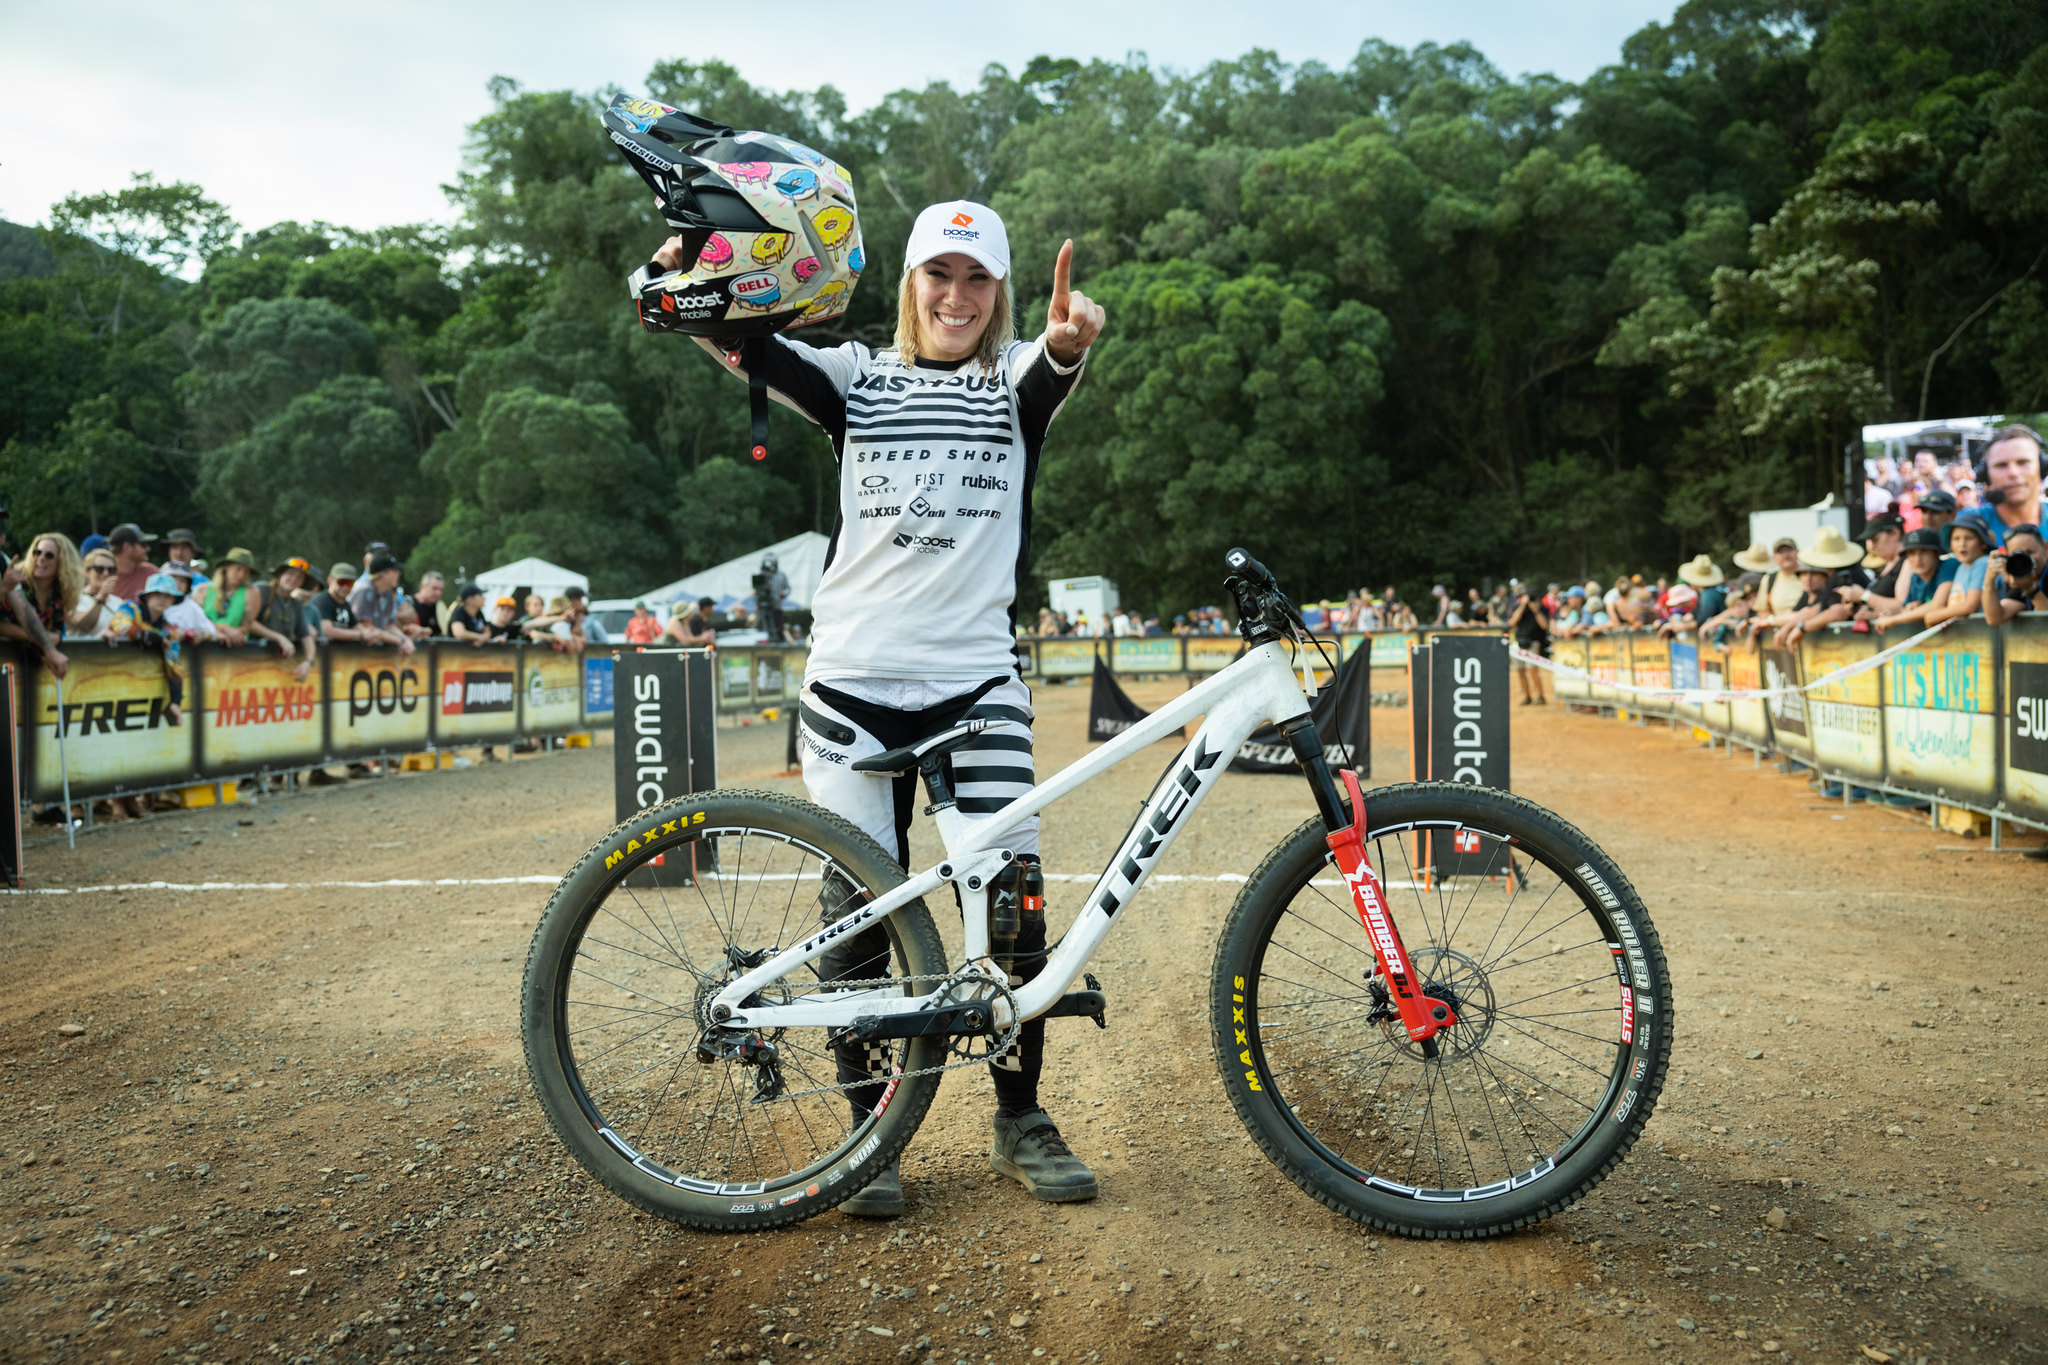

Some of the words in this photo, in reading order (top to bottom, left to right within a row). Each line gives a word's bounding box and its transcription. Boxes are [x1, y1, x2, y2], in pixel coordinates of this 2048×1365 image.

[943, 228, 980, 240] boost
[674, 291, 725, 309] boost
[736, 277, 773, 294] BELL
[680, 309, 712, 320] mobile
[857, 450, 931, 463] SPEED
[947, 449, 1008, 463] SHOP
[857, 486, 898, 497] OAKLEY
[915, 473, 945, 486] FIST
[859, 505, 902, 520] MAXXIS
[955, 508, 1002, 520] SRAM
[911, 546, 940, 555] mobile
[912, 534, 956, 550] boost
[1893, 653, 1926, 708] IT'S
[1931, 653, 1979, 713] LIVE!
[46, 697, 182, 739] TREK
[215, 685, 315, 728] MAXXIS
[1453, 657, 1487, 787] swatc
[634, 673, 669, 810] swatc
[604, 811, 706, 871] MAXXIS
[1086, 732, 1224, 918] TREK
[799, 907, 873, 952] TREK
[1357, 884, 1405, 975] BOMBER
[1575, 863, 1621, 909] HIGH
[1610, 909, 1651, 991] ROLLER
[1392, 973, 1414, 999] DJ
[1620, 986, 1633, 1042] STANS
[1233, 975, 1262, 1091] MAXXIS
[1634, 1060, 1647, 1080] EXO
[1615, 1089, 1638, 1123] TR
[848, 1133, 882, 1171] IKON
